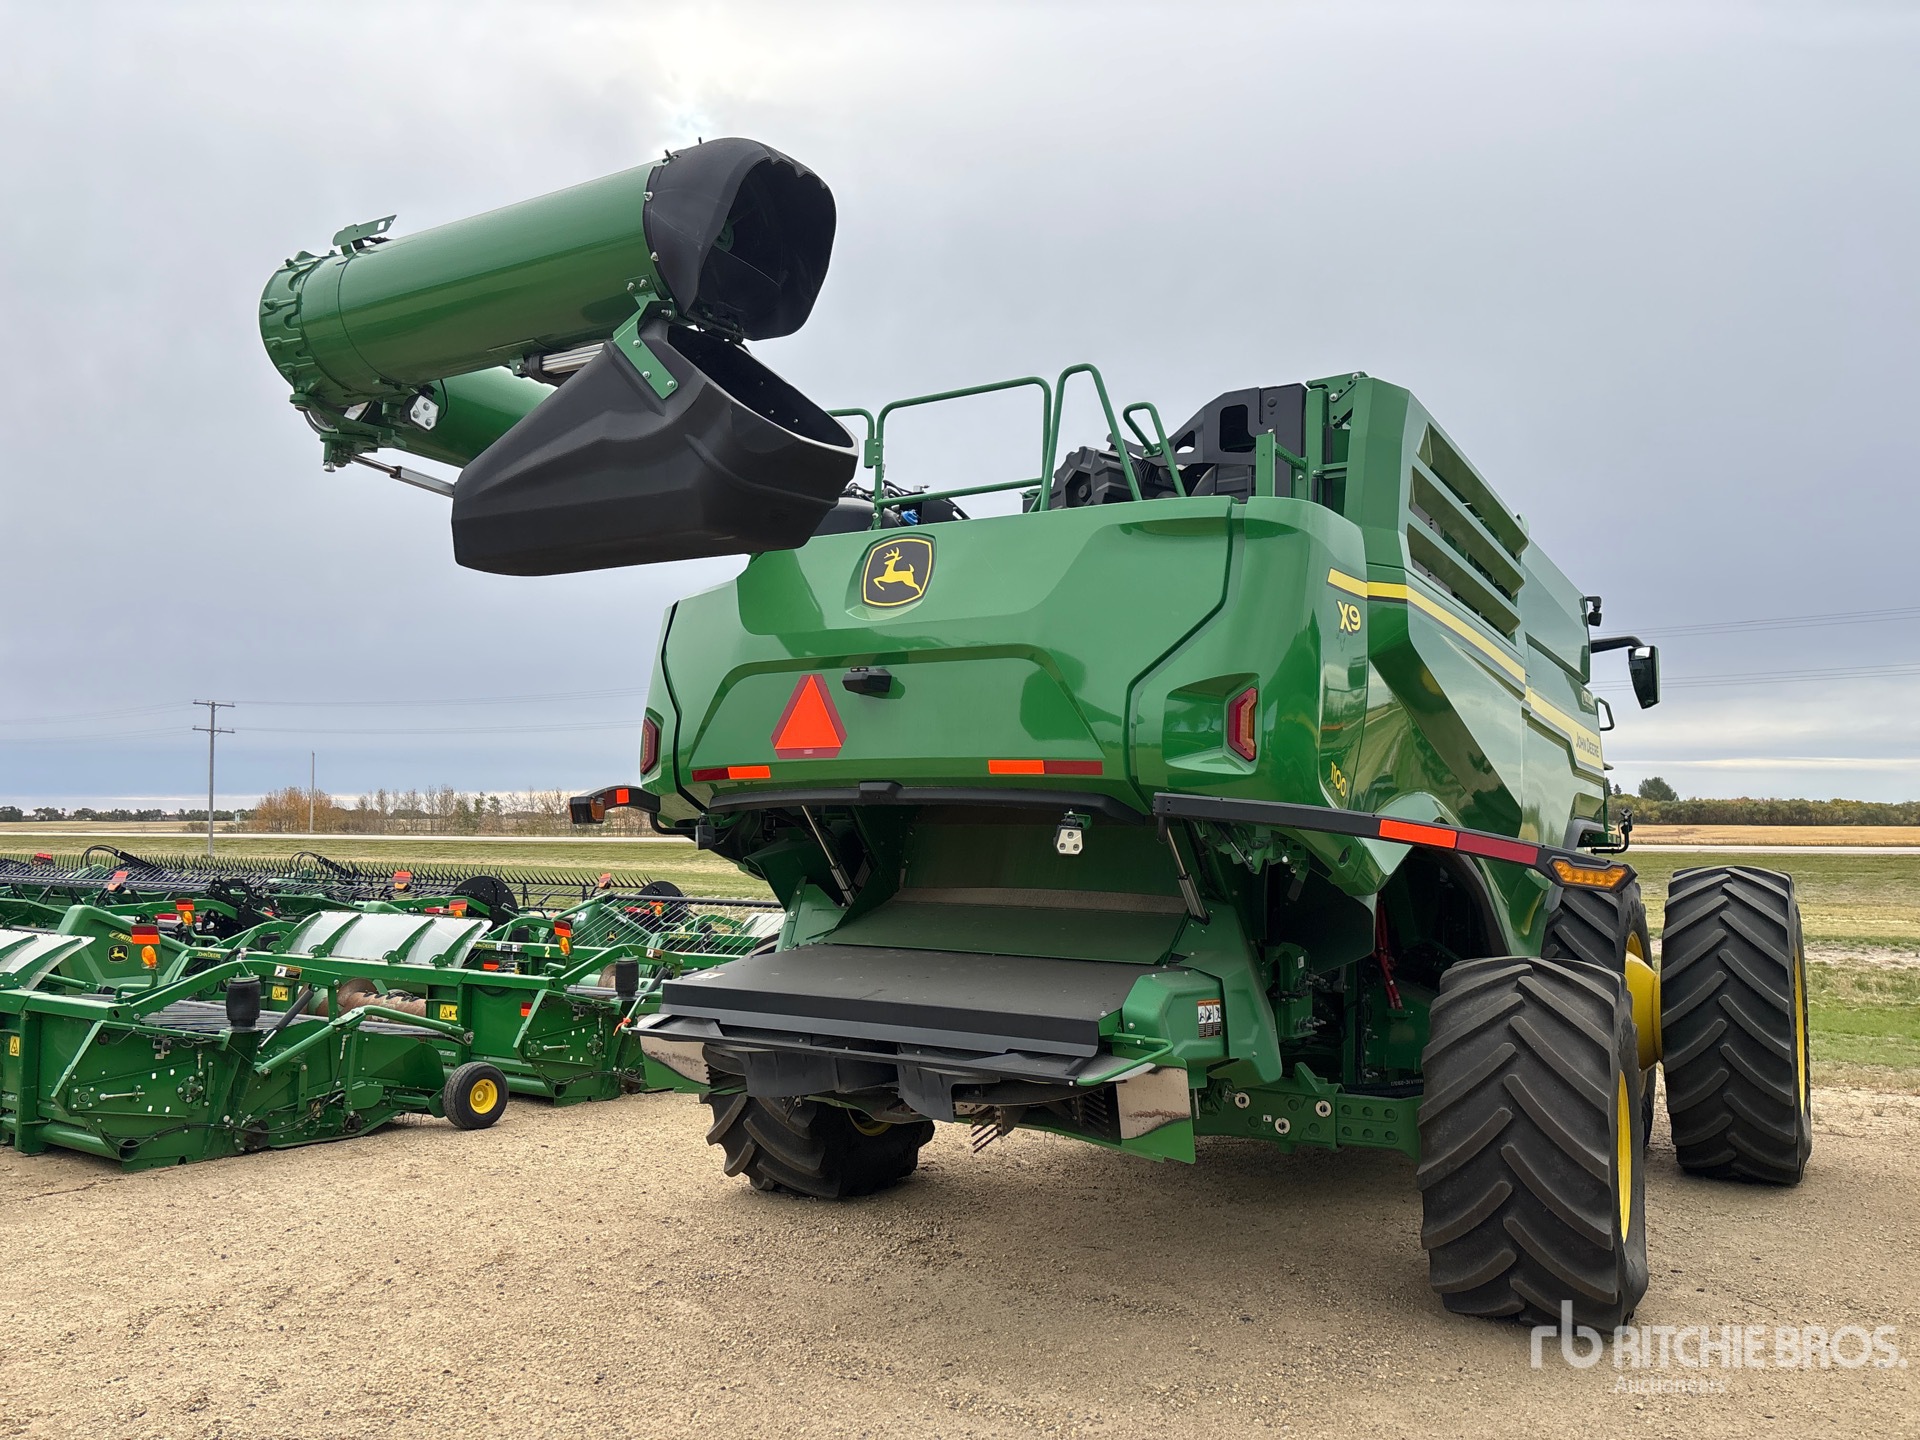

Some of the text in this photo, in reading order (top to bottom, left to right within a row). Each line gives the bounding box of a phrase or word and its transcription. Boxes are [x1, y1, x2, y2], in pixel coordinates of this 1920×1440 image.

[1336, 600, 1361, 633] X9
[1576, 732, 1600, 758] JOHN DEERE
[1331, 760, 1347, 797] 1100
[544, 945, 550, 958] 2
